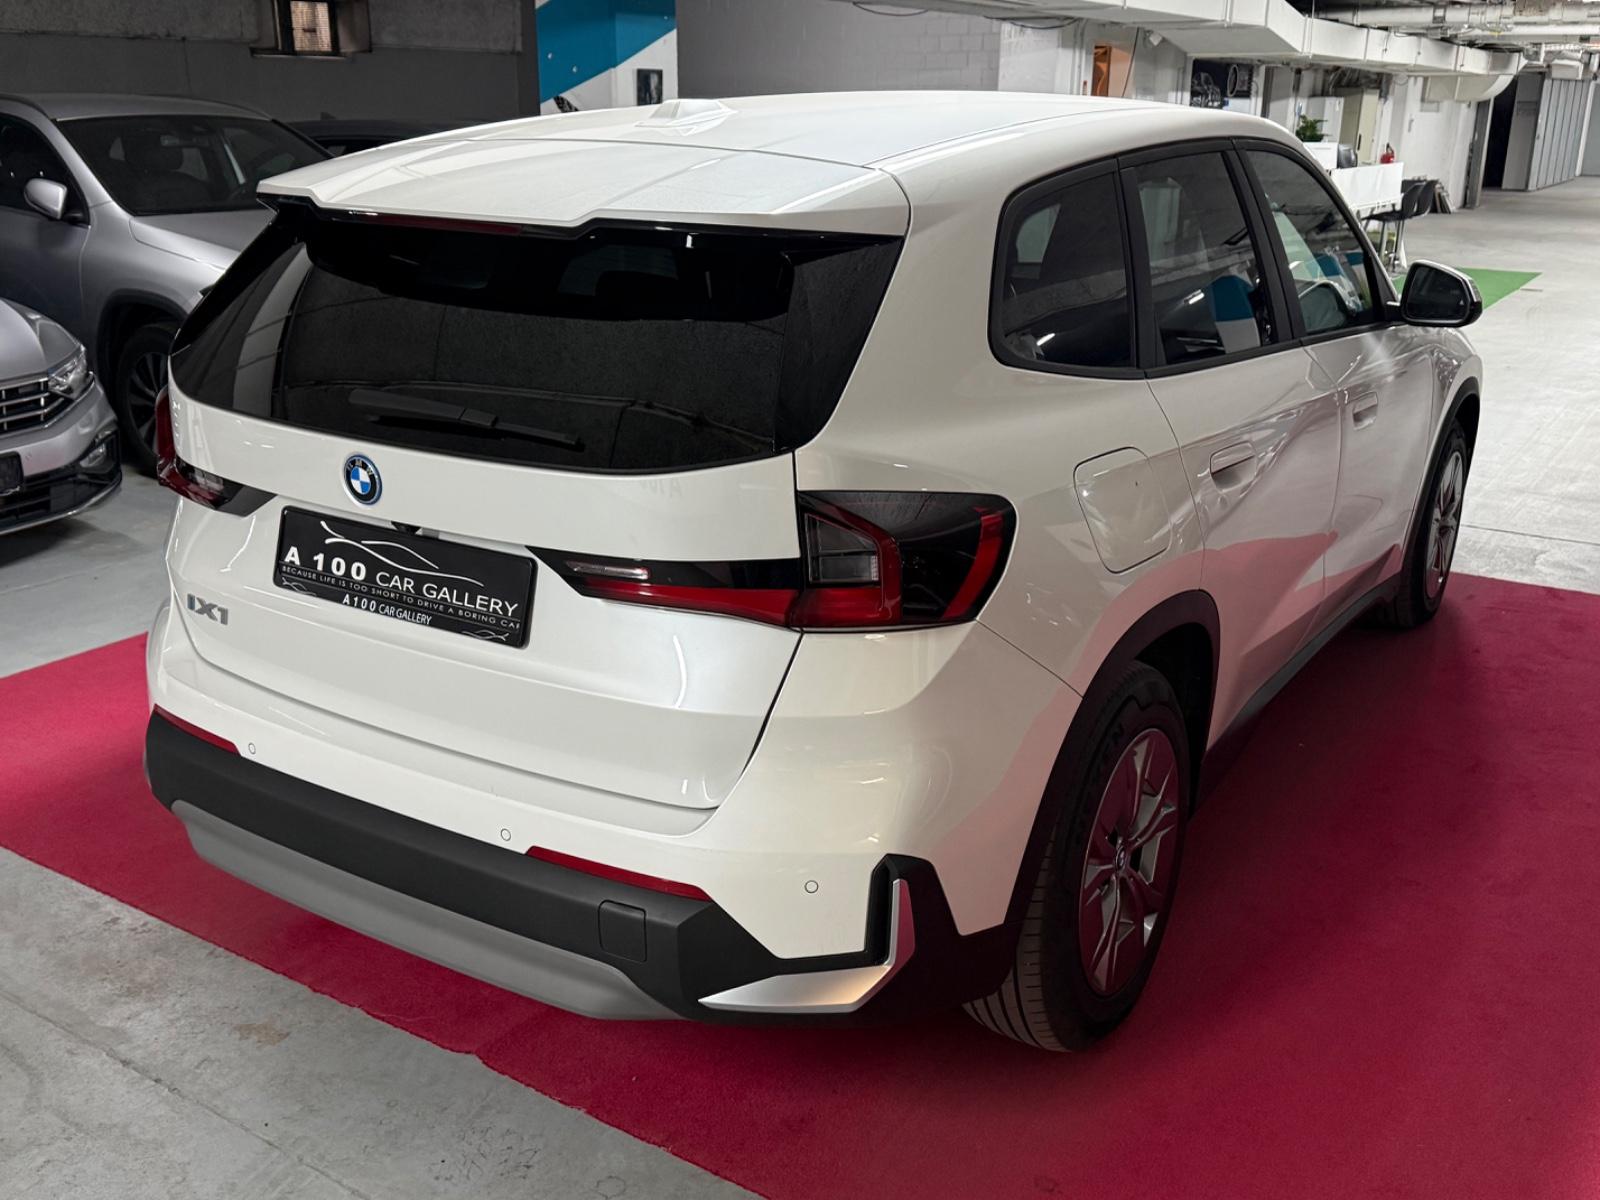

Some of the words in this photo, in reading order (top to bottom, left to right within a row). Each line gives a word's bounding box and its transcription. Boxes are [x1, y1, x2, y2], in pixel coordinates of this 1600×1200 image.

[282, 565, 317, 580] BECAUSE
[319, 576, 336, 585] LIFE
[339, 580, 346, 588] IS
[349, 583, 368, 593] TOO
[371, 587, 400, 600] SHORT
[403, 595, 414, 604] TO
[417, 598, 444, 613] DRIVE
[447, 607, 454, 615] A
[458, 609, 496, 625] BORING
[284, 546, 301, 566] A
[313, 553, 367, 581] 100
[376, 572, 416, 594] CAR
[422, 583, 518, 617] GALLERY
